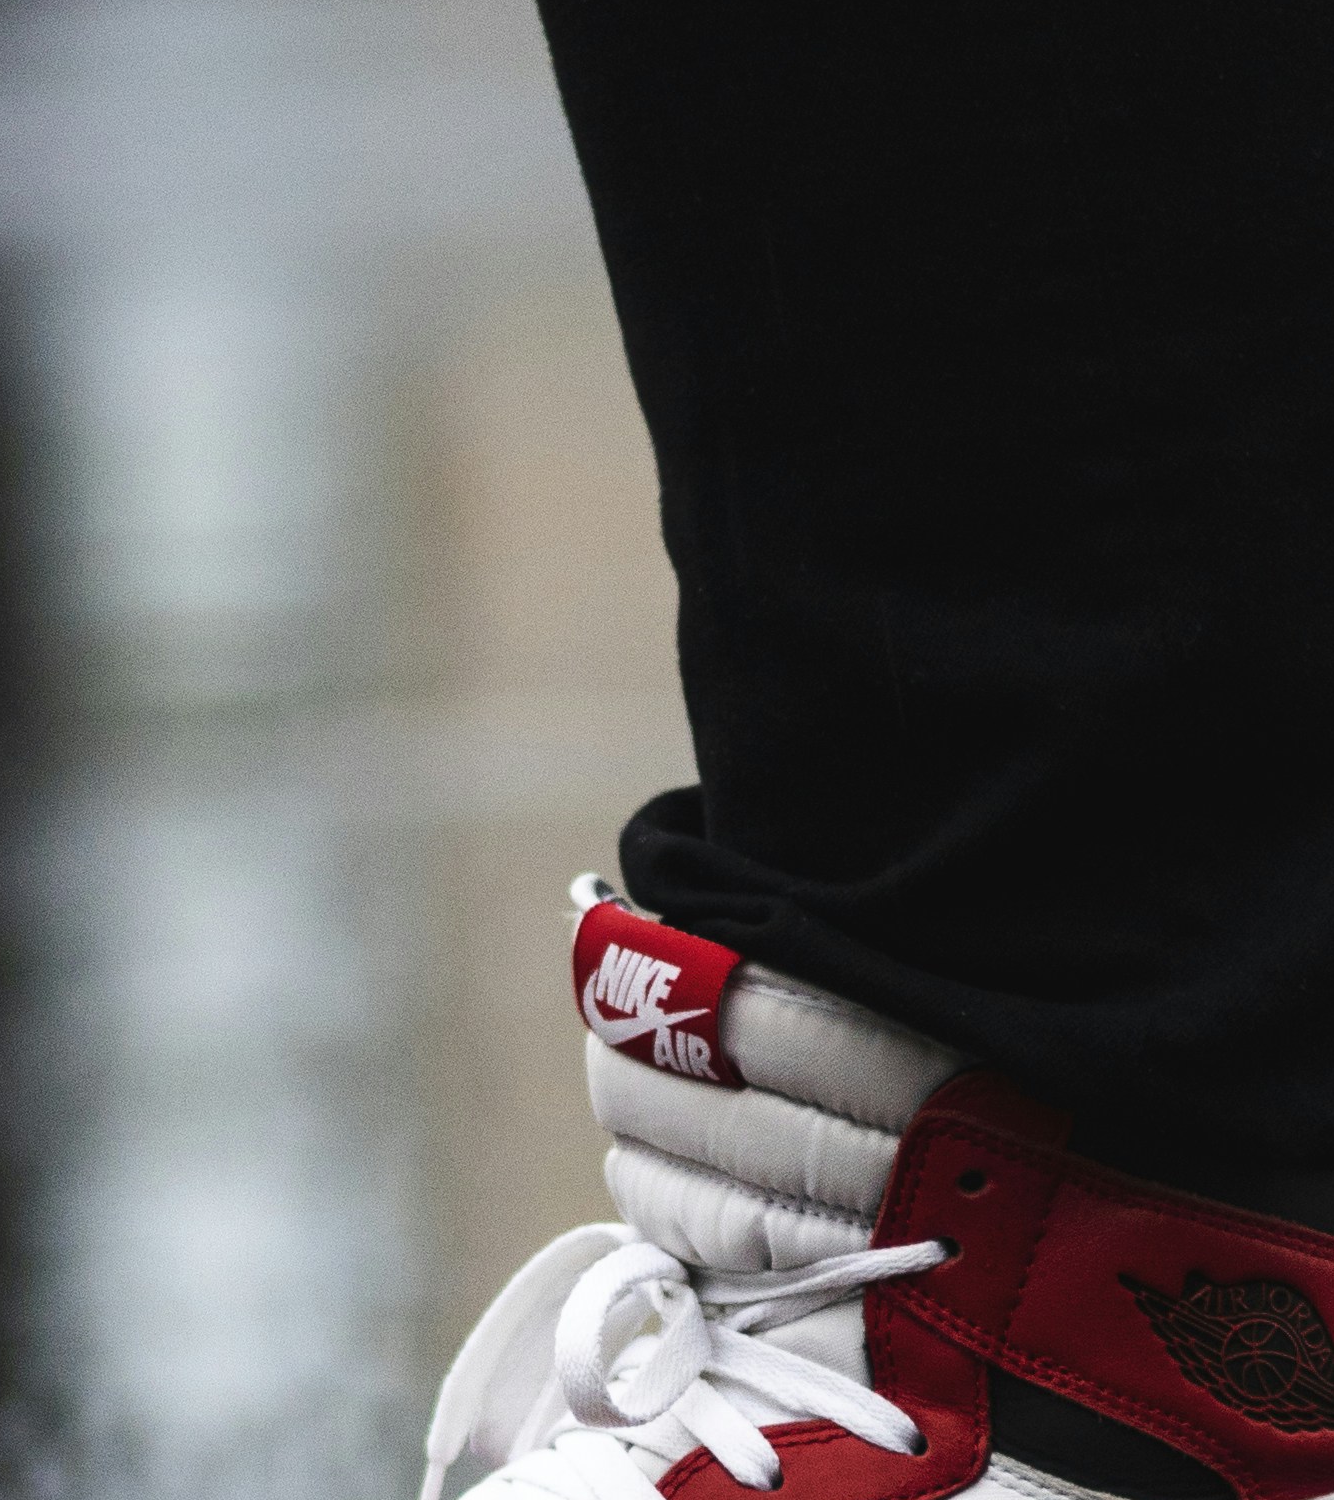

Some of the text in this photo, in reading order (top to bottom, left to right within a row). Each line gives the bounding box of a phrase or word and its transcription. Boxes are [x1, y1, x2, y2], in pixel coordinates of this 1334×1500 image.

[595, 943, 681, 1017] NIKE
[653, 1023, 720, 1081] AIR
[1188, 1283, 1250, 1314] AIR
